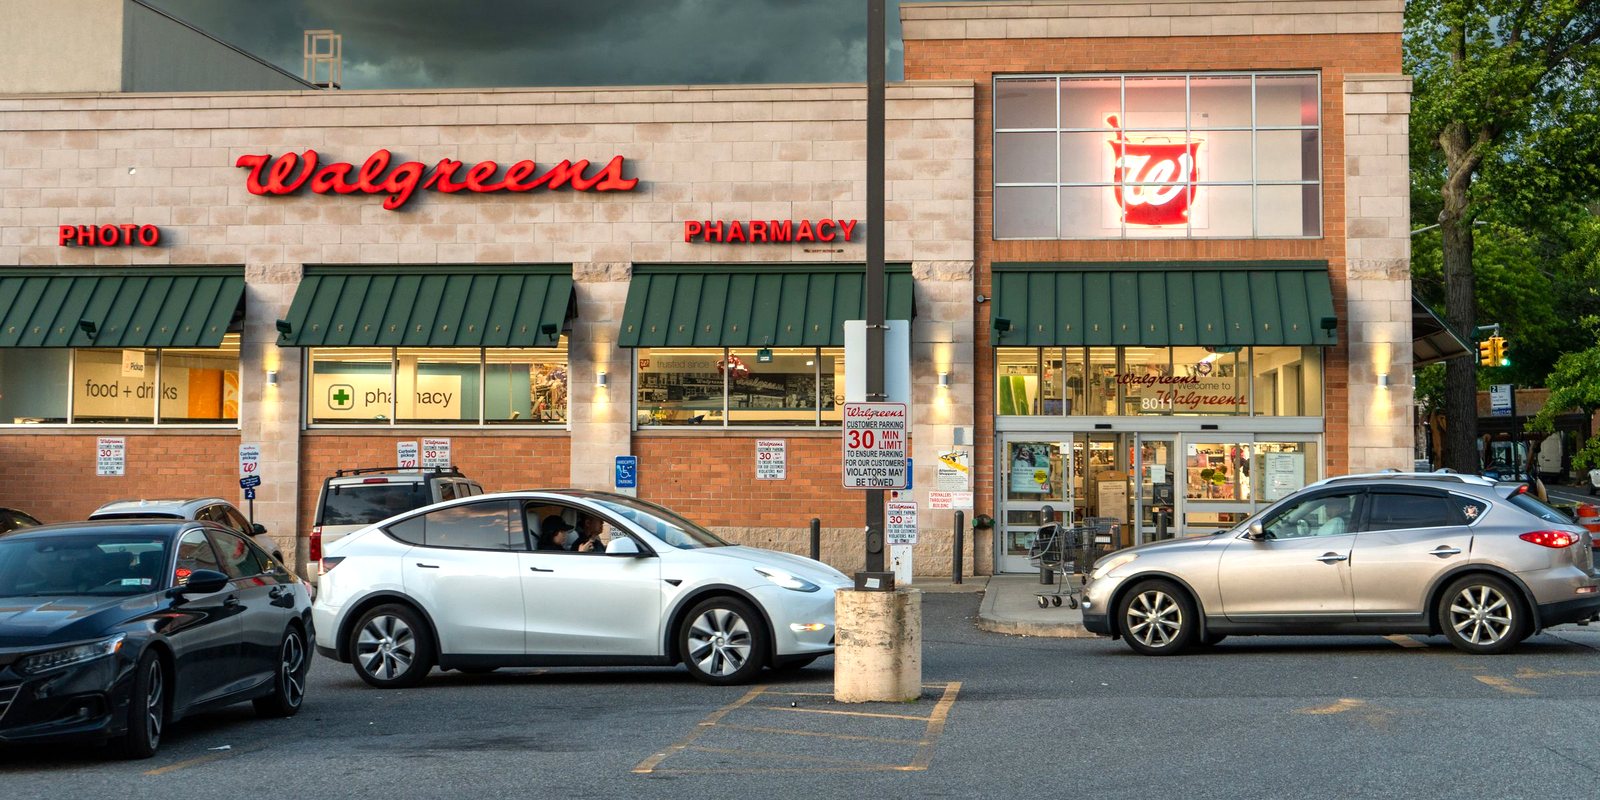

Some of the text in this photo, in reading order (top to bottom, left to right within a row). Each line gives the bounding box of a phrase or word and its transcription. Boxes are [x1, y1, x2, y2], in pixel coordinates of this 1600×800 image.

[236, 149, 640, 211] Walgreens
[58, 224, 160, 247] PHOTO
[684, 218, 857, 243] PHARMACY
[657, 360, 686, 368] trusted
[687, 360, 710, 368] since
[1114, 373, 1201, 388] Walgreens
[1178, 381, 1231, 390] Welcome to
[86, 379, 119, 398] food
[136, 382, 178, 400] driks
[1142, 397, 1173, 410] 8011
[1156, 389, 1248, 410] Walgreens
[846, 407, 904, 420] Walgreens
[846, 420, 904, 429] CUSTOMER PARKING
[848, 430, 875, 450] 30
[882, 431, 899, 439] MIN
[878, 441, 903, 449] LIMIT
[847, 450, 903, 458] TO ENSURE PARKING
[846, 468, 904, 477] VIOLATORS MAY
[856, 478, 894, 487] BE TOWED
[890, 516, 903, 524] 30
